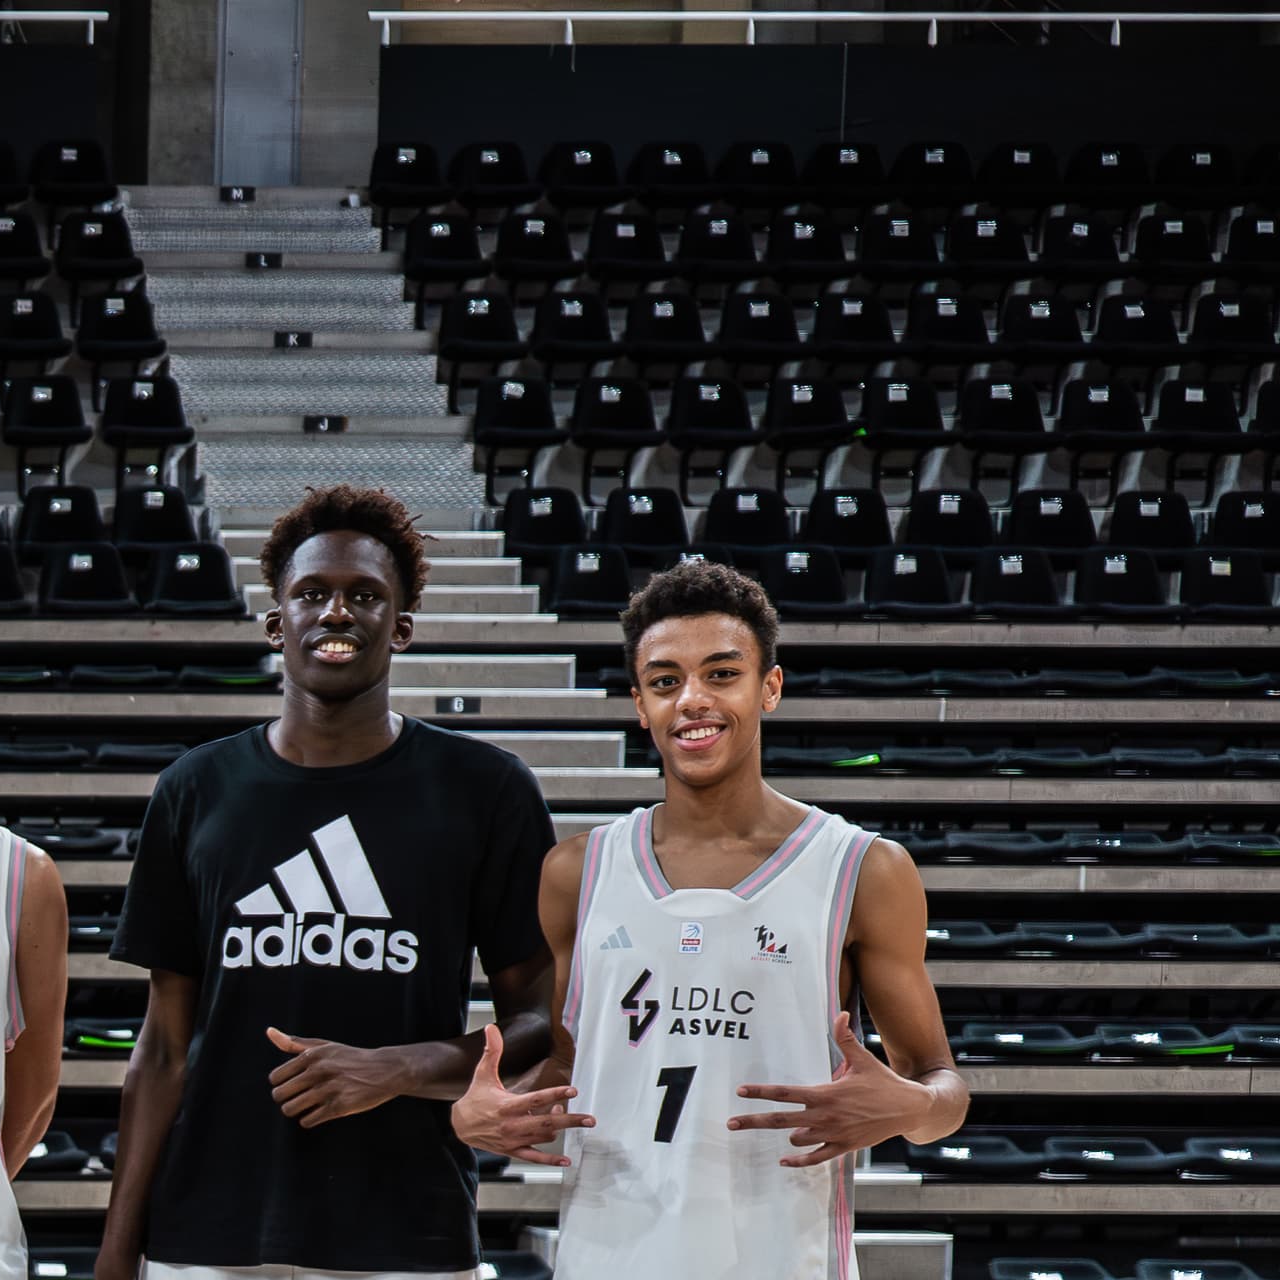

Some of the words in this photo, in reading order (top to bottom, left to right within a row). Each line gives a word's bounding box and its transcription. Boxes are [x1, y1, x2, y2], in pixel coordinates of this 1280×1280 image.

[222, 911, 419, 974] adidas
[671, 985, 756, 1016] LDLC
[668, 1017, 751, 1041] ASVEL
[653, 1065, 698, 1144] 1
